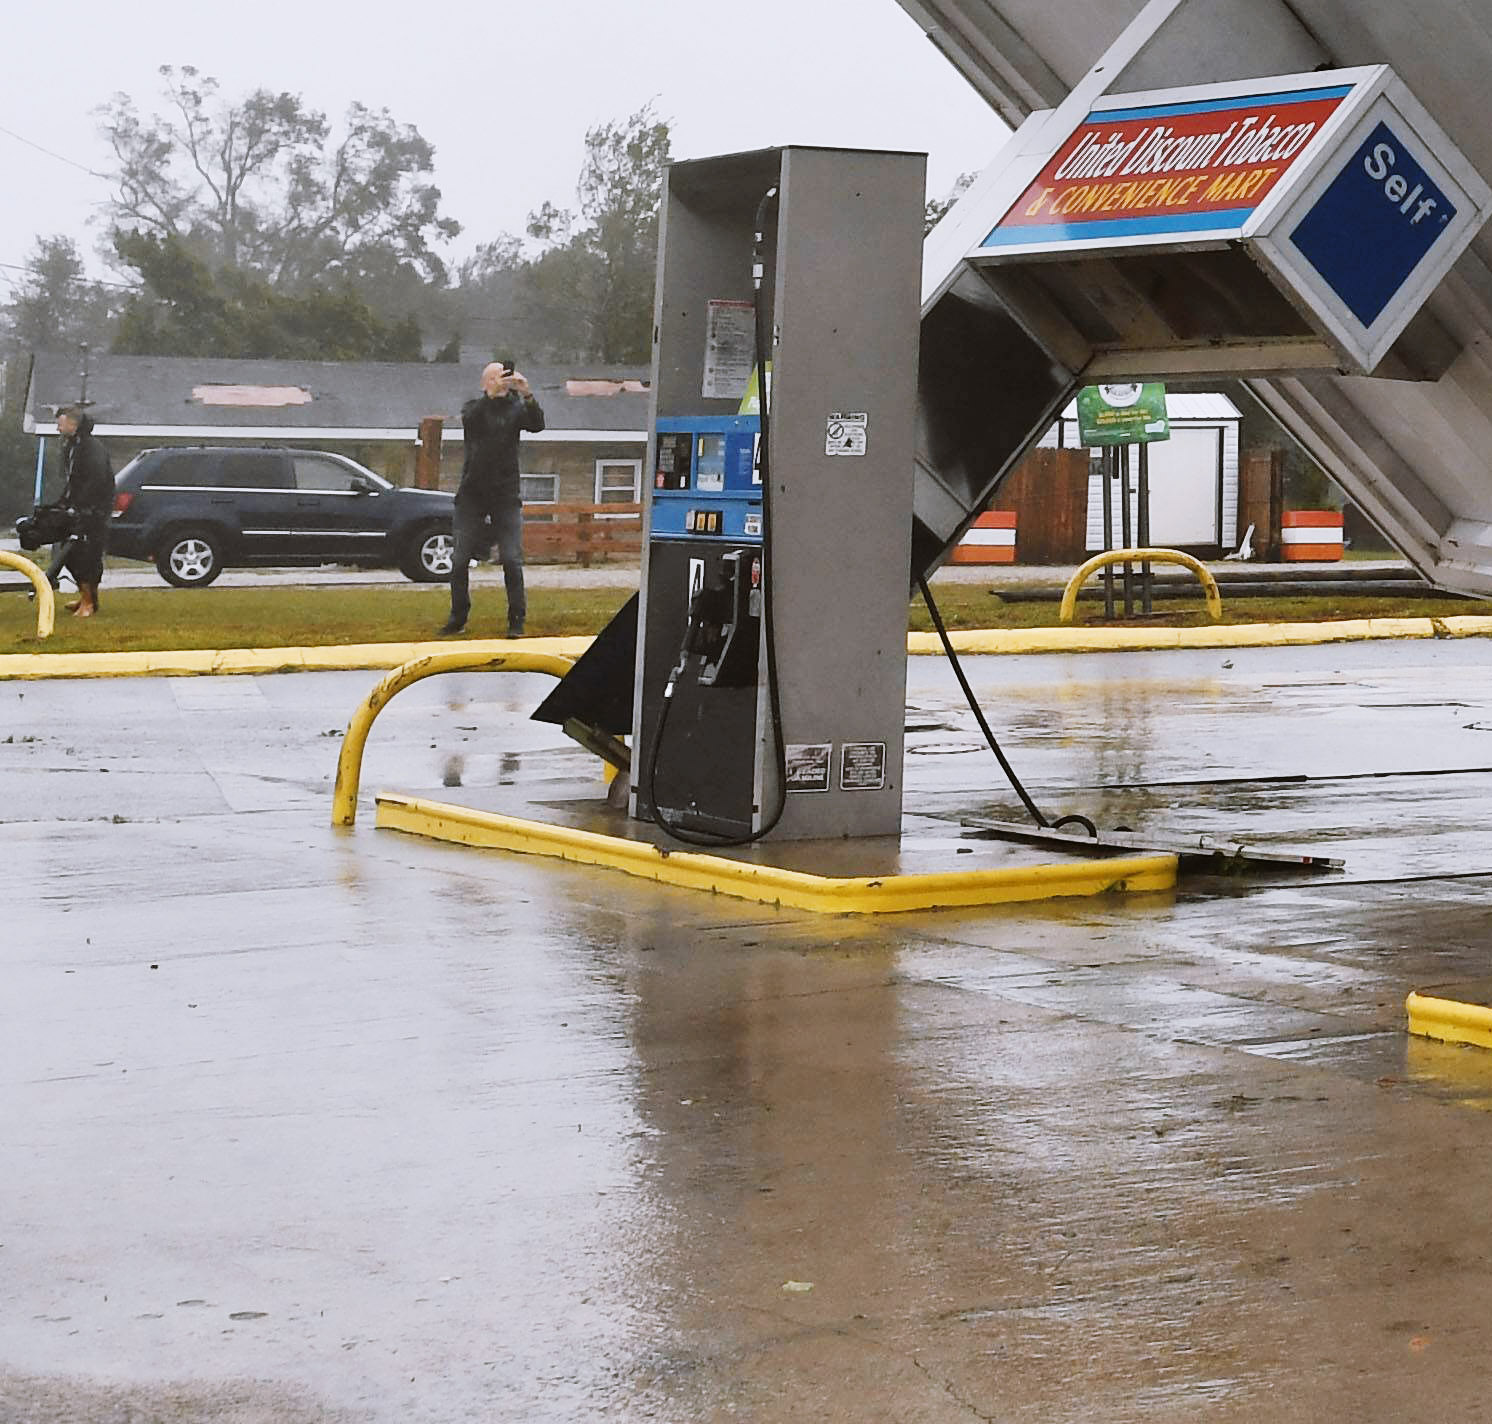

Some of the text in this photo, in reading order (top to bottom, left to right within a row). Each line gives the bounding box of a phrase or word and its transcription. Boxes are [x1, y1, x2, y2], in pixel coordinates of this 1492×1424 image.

[1054, 115, 1316, 181] United Discount Tobacco
[1025, 168, 1279, 216] & CONVENIENCE MART
[1364, 143, 1437, 224] Self
